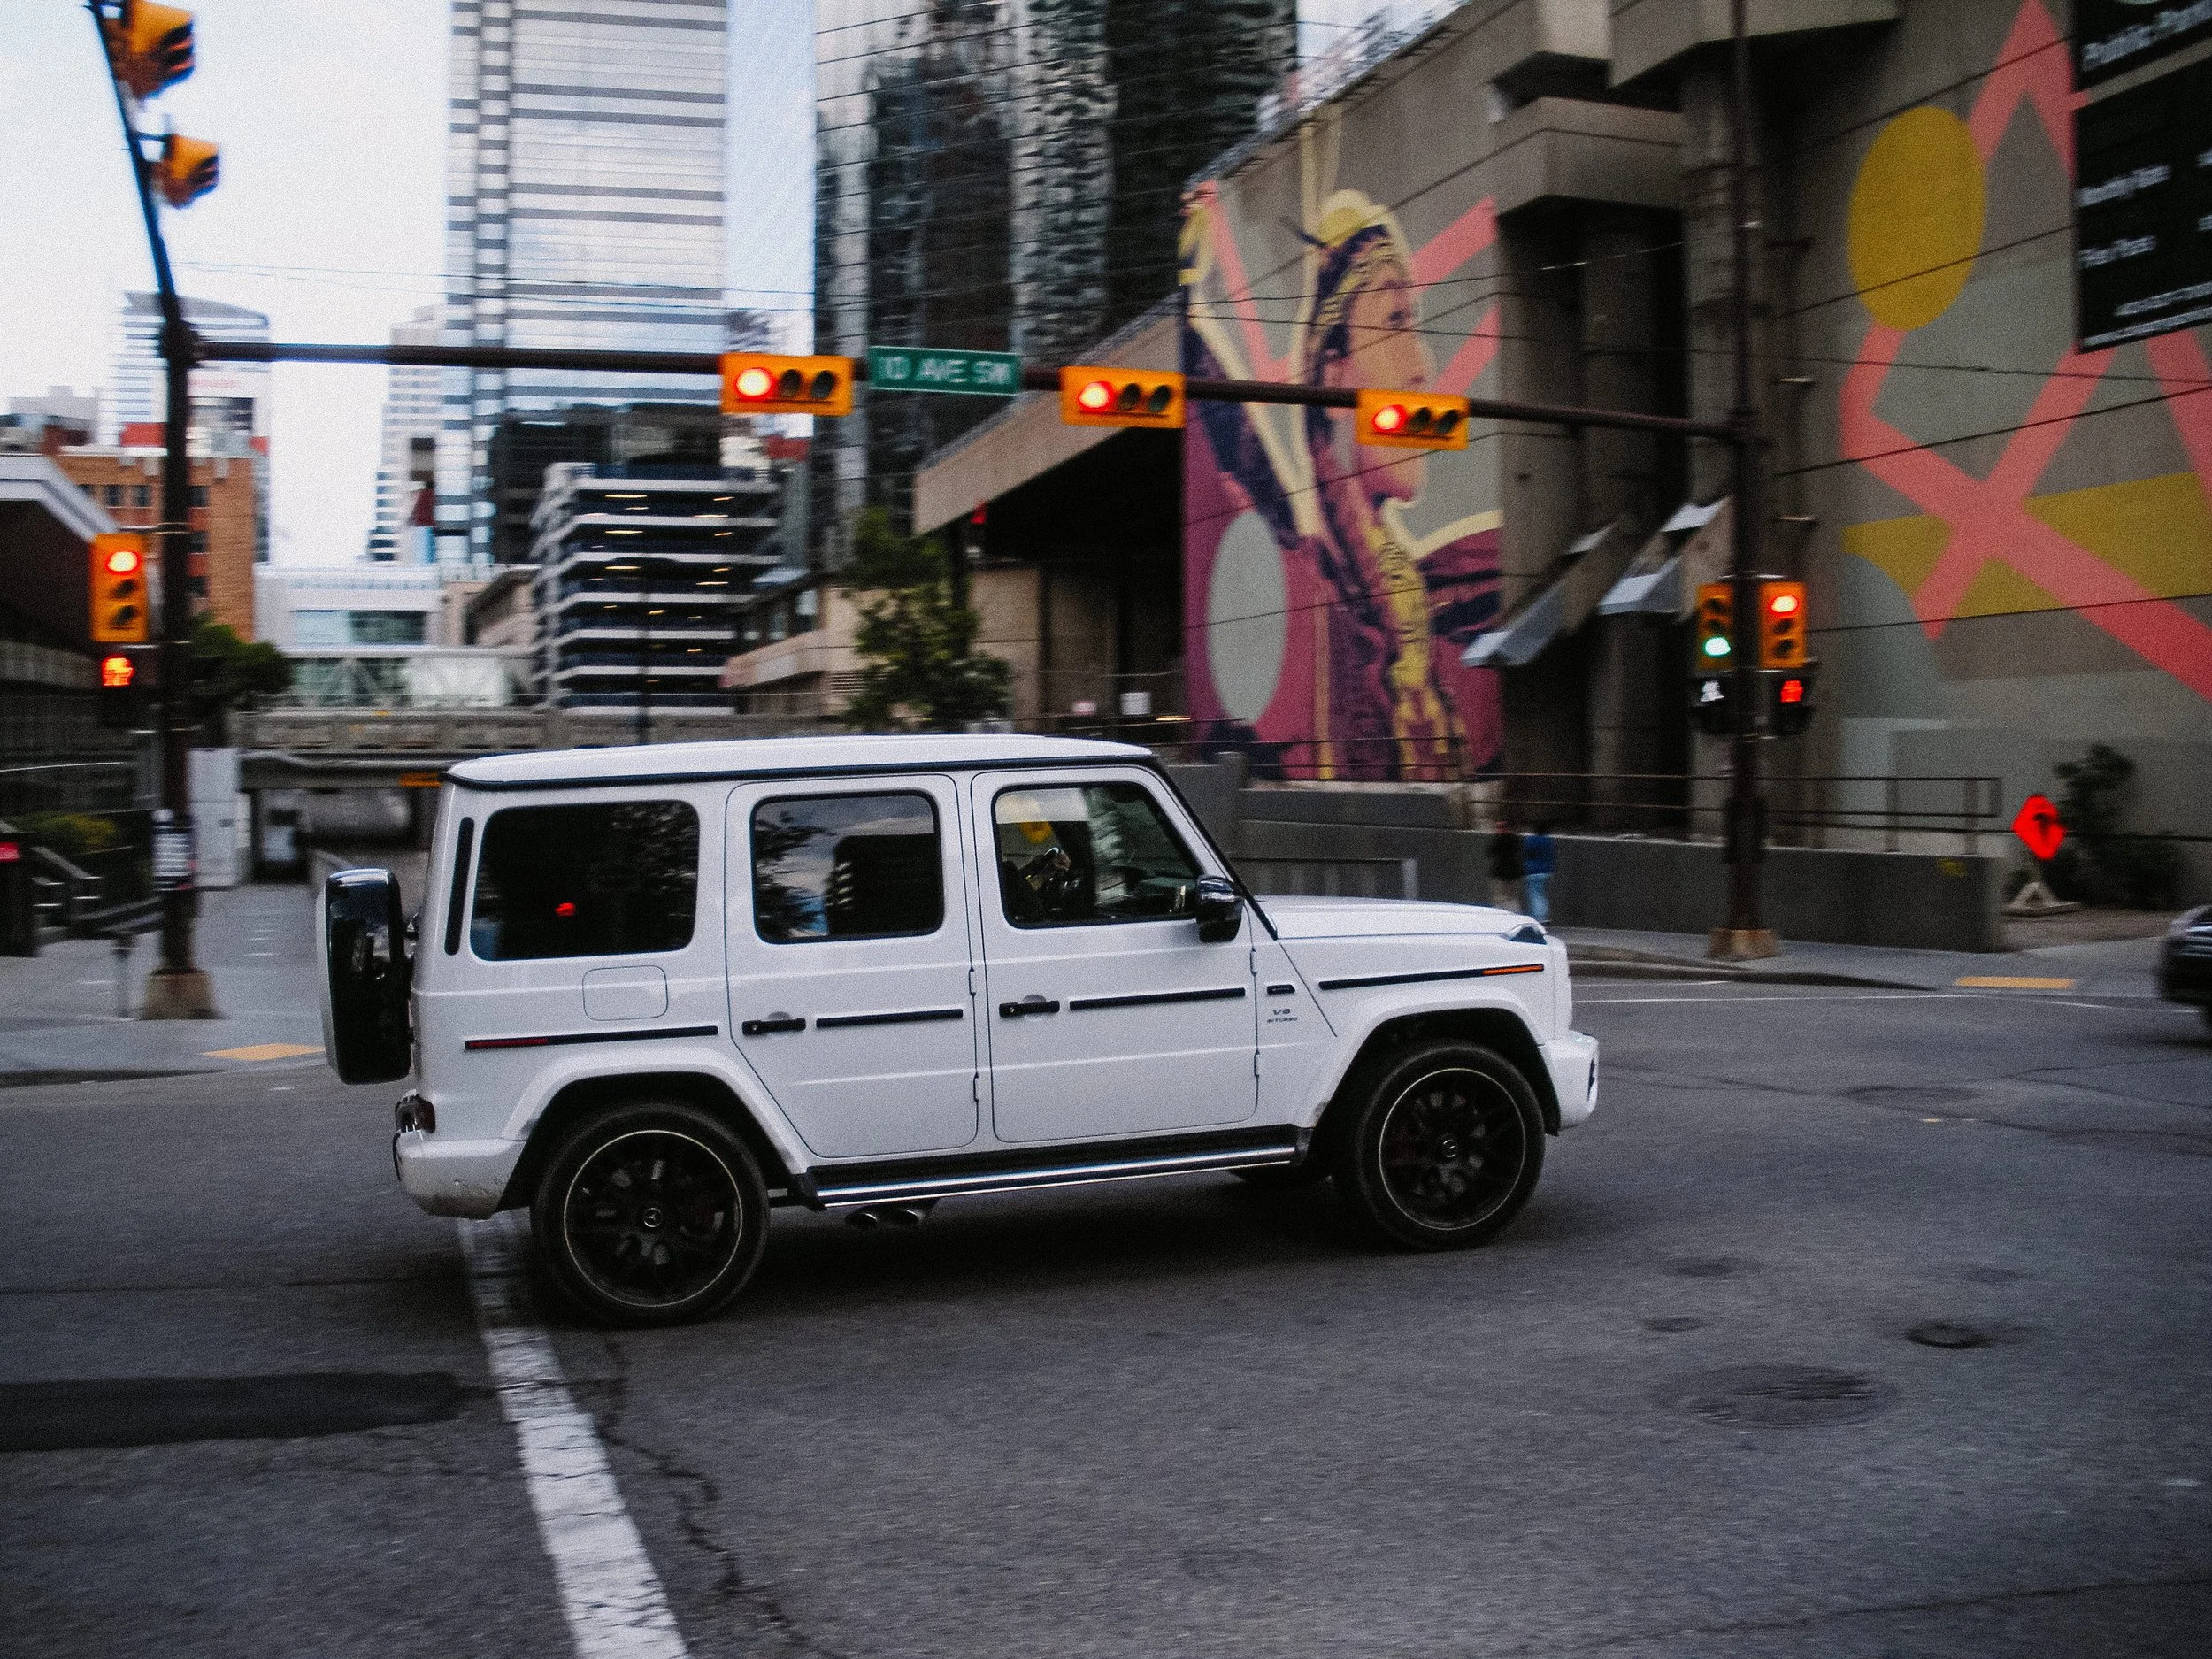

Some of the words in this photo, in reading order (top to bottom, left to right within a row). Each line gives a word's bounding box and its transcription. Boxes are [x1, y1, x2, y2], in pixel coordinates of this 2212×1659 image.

[879, 355, 912, 380] 10
[916, 358, 968, 383] AVE
[972, 360, 1012, 385] SW
